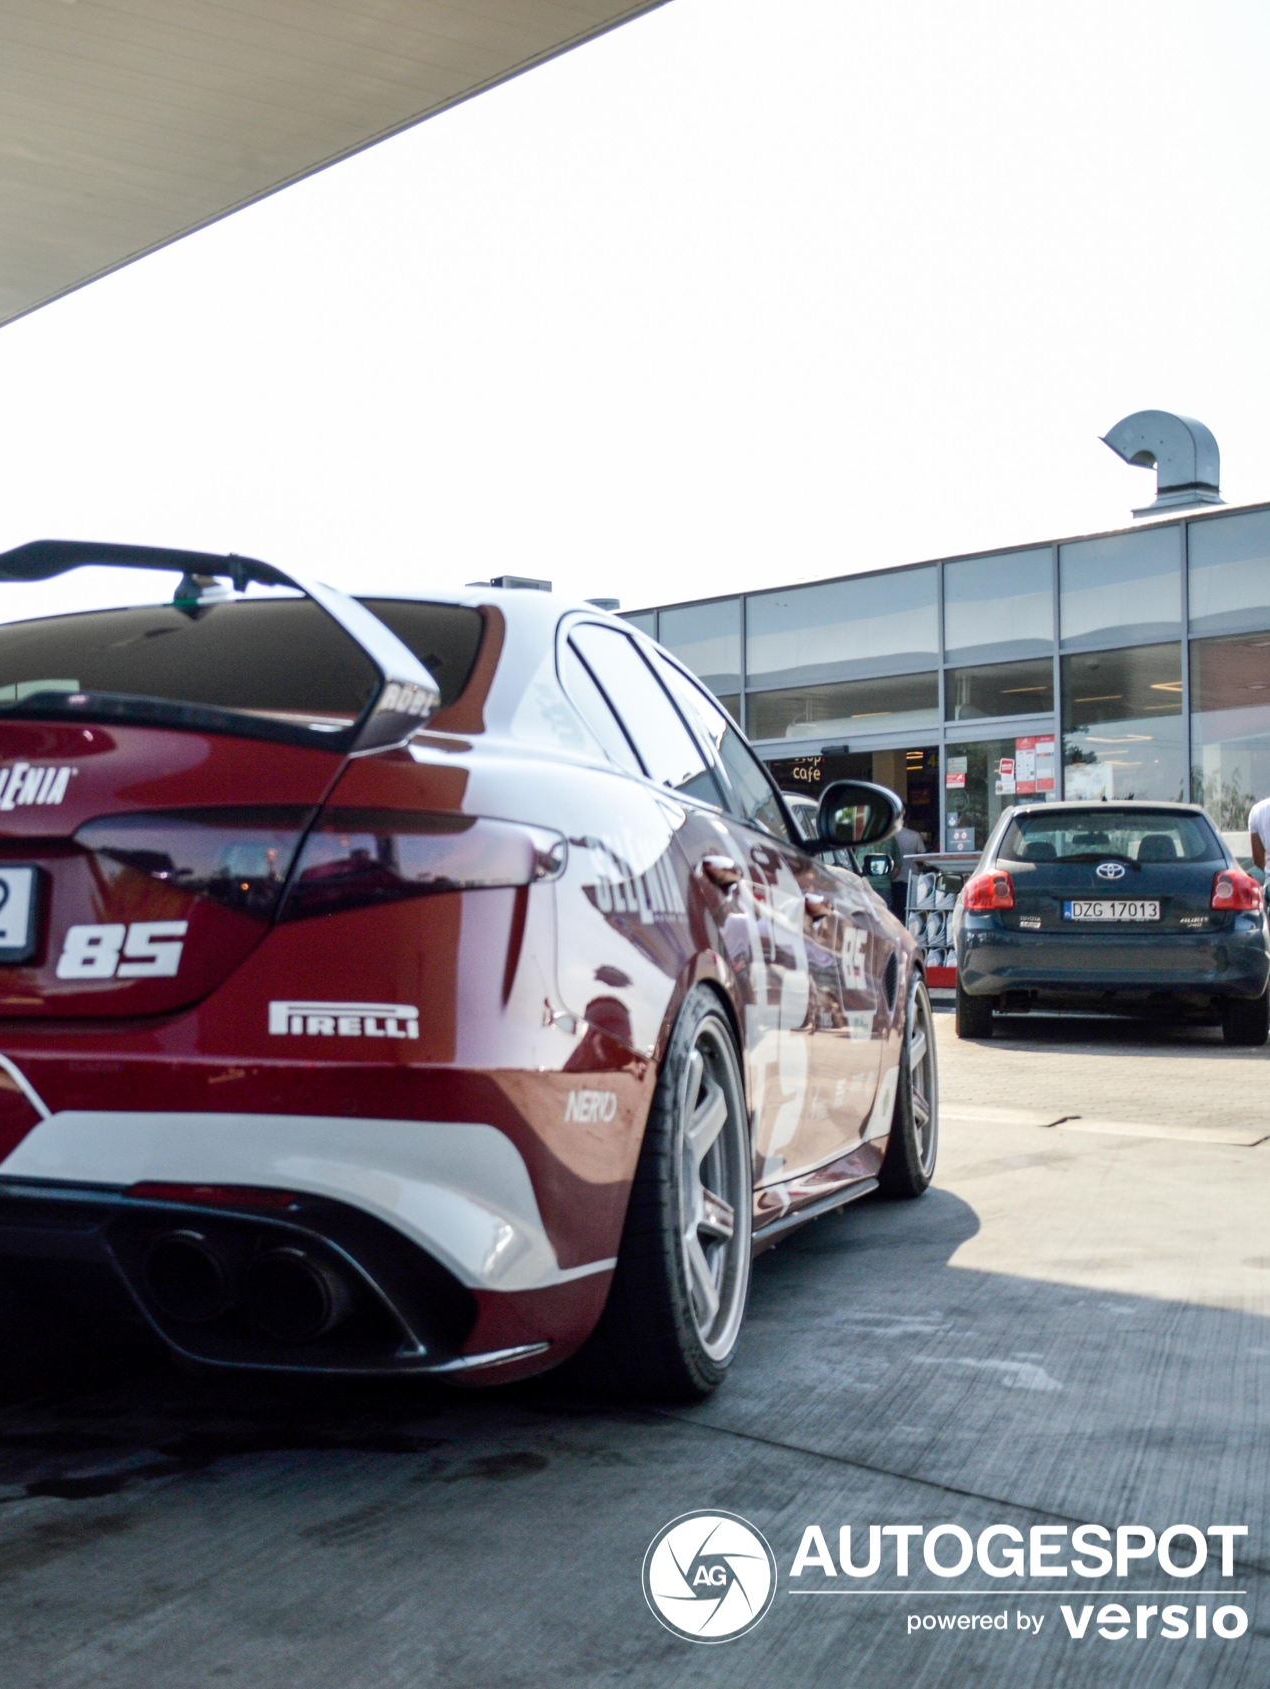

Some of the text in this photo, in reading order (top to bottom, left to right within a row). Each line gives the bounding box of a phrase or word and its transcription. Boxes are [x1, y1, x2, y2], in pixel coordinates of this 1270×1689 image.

[792, 766, 821, 783] cafe
[1072, 902, 1158, 917] DZG 17013
[55, 920, 189, 980] 85
[268, 1000, 420, 1040] PIRELLI
